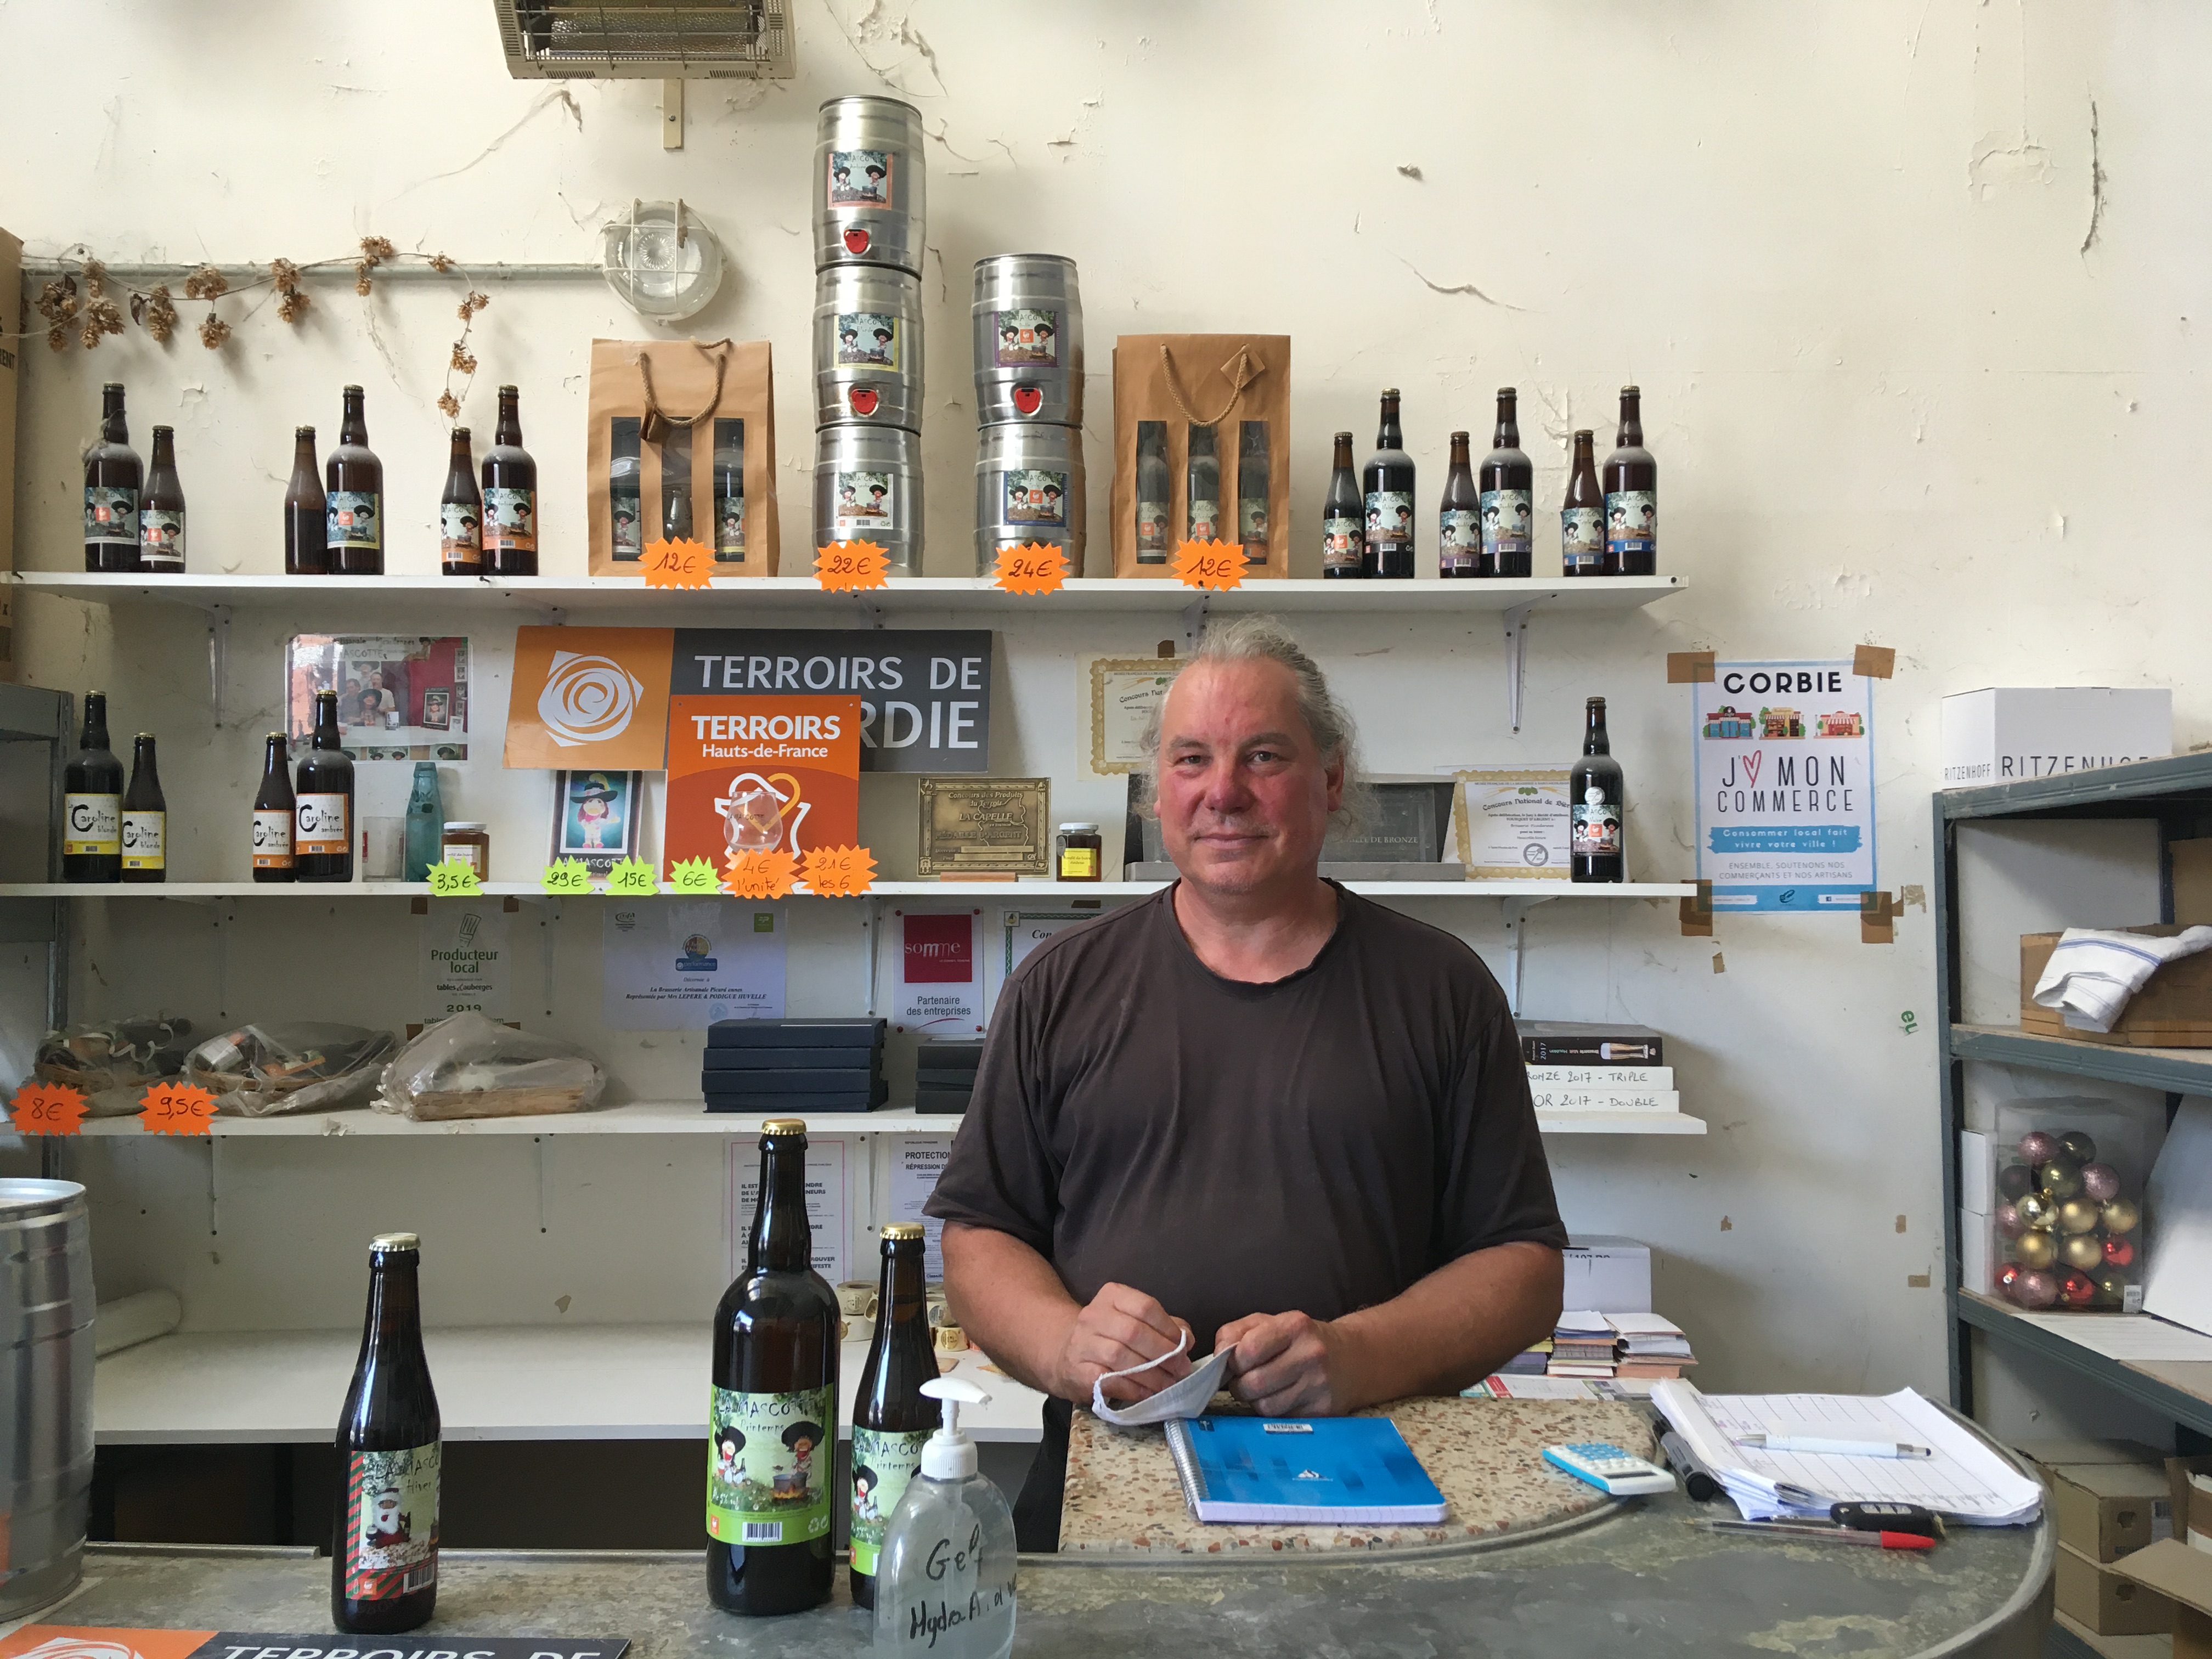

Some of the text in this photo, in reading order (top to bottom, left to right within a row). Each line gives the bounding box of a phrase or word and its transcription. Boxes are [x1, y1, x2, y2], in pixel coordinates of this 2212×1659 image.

[651, 552, 696, 574] 12€
[828, 555, 871, 574] 22€
[1008, 558, 1052, 578] 24€
[1186, 556, 1232, 578] 12€
[695, 656, 981, 690] TERROIRS DE
[1724, 672, 1842, 694] CORBIE
[1120, 692, 1149, 703] Concours
[691, 715, 840, 740] TERROIRS
[703, 744, 828, 758] Hauts-de-France
[1779, 756, 1844, 787] MON
[1944, 763, 1991, 781] RITZENHOFF
[1718, 789, 1853, 812] COMMERCE
[72, 804, 115, 832] Caroline
[299, 804, 340, 832] Caroline
[973, 812, 1013, 821] CAPELLE
[122, 821, 159, 848] Caroline
[253, 821, 286, 847] Caroline
[743, 858, 771, 873] 4€
[815, 857, 851, 871] 21€
[1729, 862, 1773, 870] ENSEMBLE,
[547, 872, 583, 887] 29€
[618, 872, 646, 888] 15€
[683, 871, 708, 886] 6€
[819, 875, 850, 889] les 6
[1719, 872, 1780, 881] COMMERÇANTS
[737, 878, 780, 892] l'unité
[431, 948, 498, 960] Producteur
[905, 943, 961, 957] somme
[450, 961, 479, 973] local
[463, 984, 493, 992] auberges
[917, 996, 960, 1005] Partenaire
[907, 1007, 971, 1017] des entreprises
[1567, 1072, 1592, 1083] 2017
[31, 1097, 64, 1120] 8€
[157, 1097, 205, 1120] 9,5€
[1560, 1095, 1592, 1107] 2017
[741, 1419, 784, 1435] Printemps
[375, 1462, 394, 1480] LA
